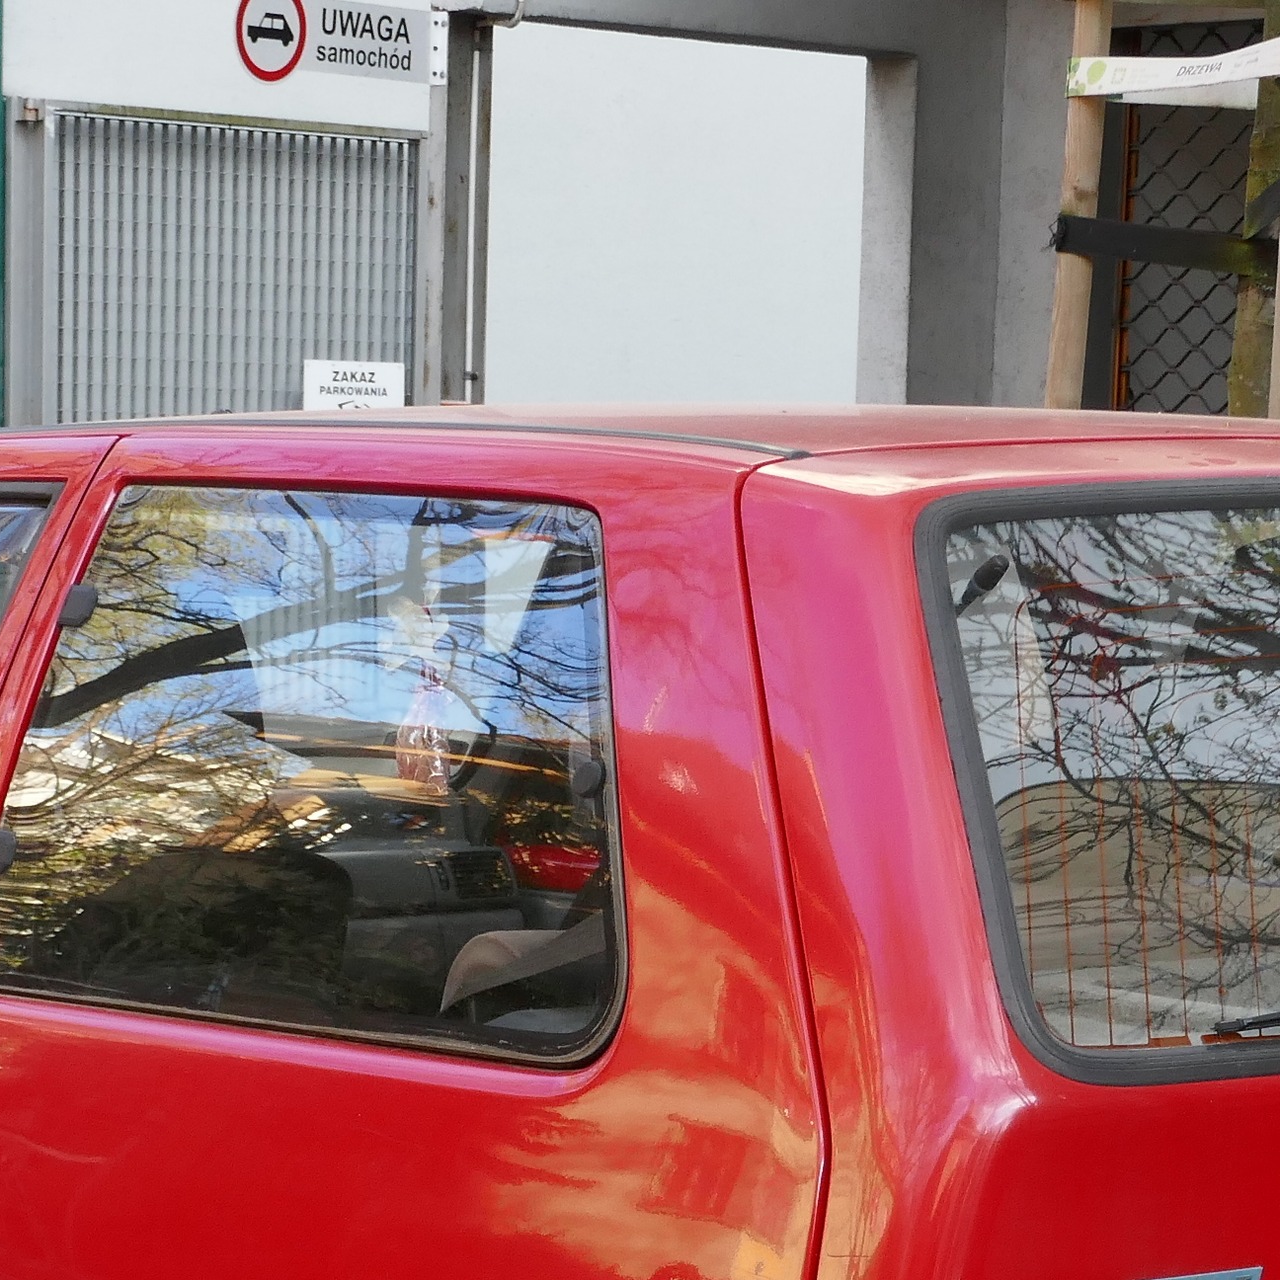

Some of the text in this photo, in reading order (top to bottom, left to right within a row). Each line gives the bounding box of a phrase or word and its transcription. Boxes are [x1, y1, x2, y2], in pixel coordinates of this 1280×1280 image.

[321, 8, 410, 44] UWAGA
[316, 45, 411, 71] samochód
[1176, 62, 1223, 77] DRZEWA
[332, 371, 375, 384] ZAKAZ
[319, 386, 388, 396] PARKOWANIA
